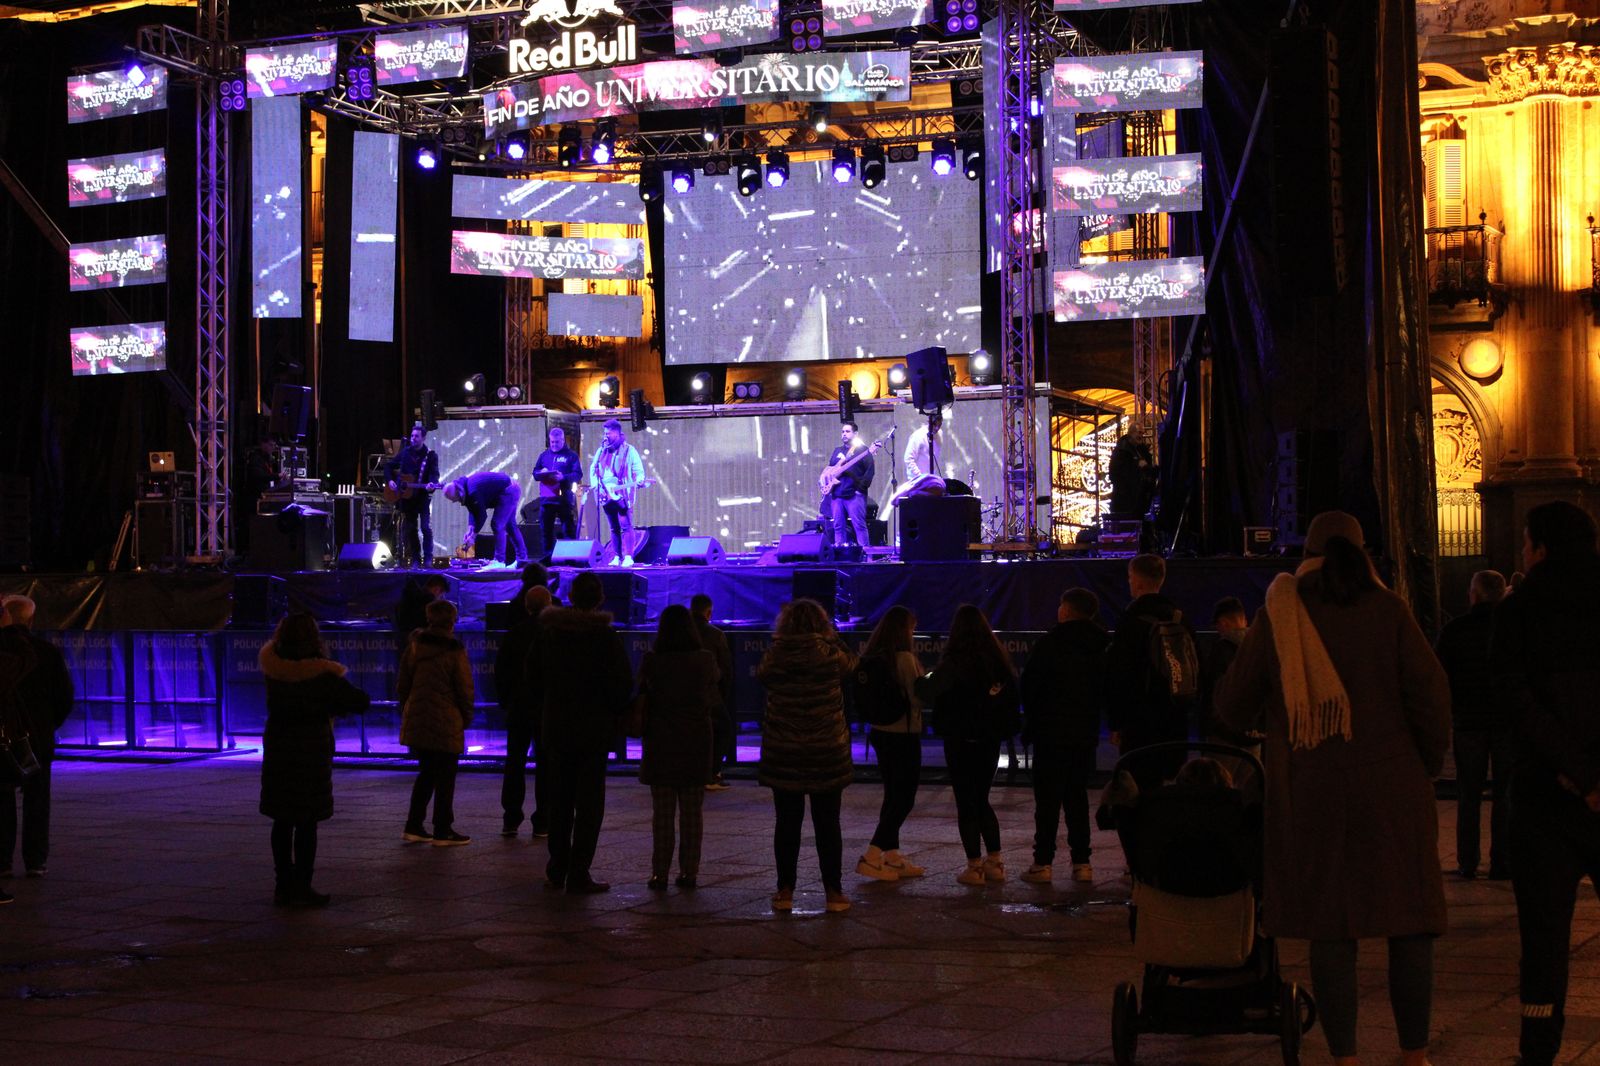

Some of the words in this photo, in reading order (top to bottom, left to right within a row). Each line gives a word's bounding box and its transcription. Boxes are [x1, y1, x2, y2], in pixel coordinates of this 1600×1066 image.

[731, 4, 756, 15] AÑO
[427, 39, 449, 50] AÑO
[508, 31, 570, 74] Red
[574, 24, 637, 66] Bull
[1131, 66, 1158, 78] AÑO
[844, 78, 905, 88] SALAMANCA
[1074, 76, 1181, 94] UNIVERSITARIO
[487, 106, 512, 128] FIN
[514, 96, 540, 118] DE
[542, 85, 590, 112] AÑO
[595, 64, 840, 107] UNIVERSITARIO
[1131, 169, 1158, 180] AÑO
[1074, 179, 1181, 197] UNIVERSITARIO
[501, 239, 526, 251] FIN
[528, 240, 550, 252] DE
[553, 239, 588, 254] AÑO
[477, 250, 618, 270] UNIVERSITARIO
[1132, 273, 1160, 285] AÑO
[1075, 282, 1184, 300] UNIVERSITARIO
[140, 637, 176, 649] POLICIA
[178, 637, 208, 649] LOCAL
[325, 639, 364, 650] POLICIA
[366, 639, 398, 650] LOCAL
[466, 639, 498, 650] LOCAL
